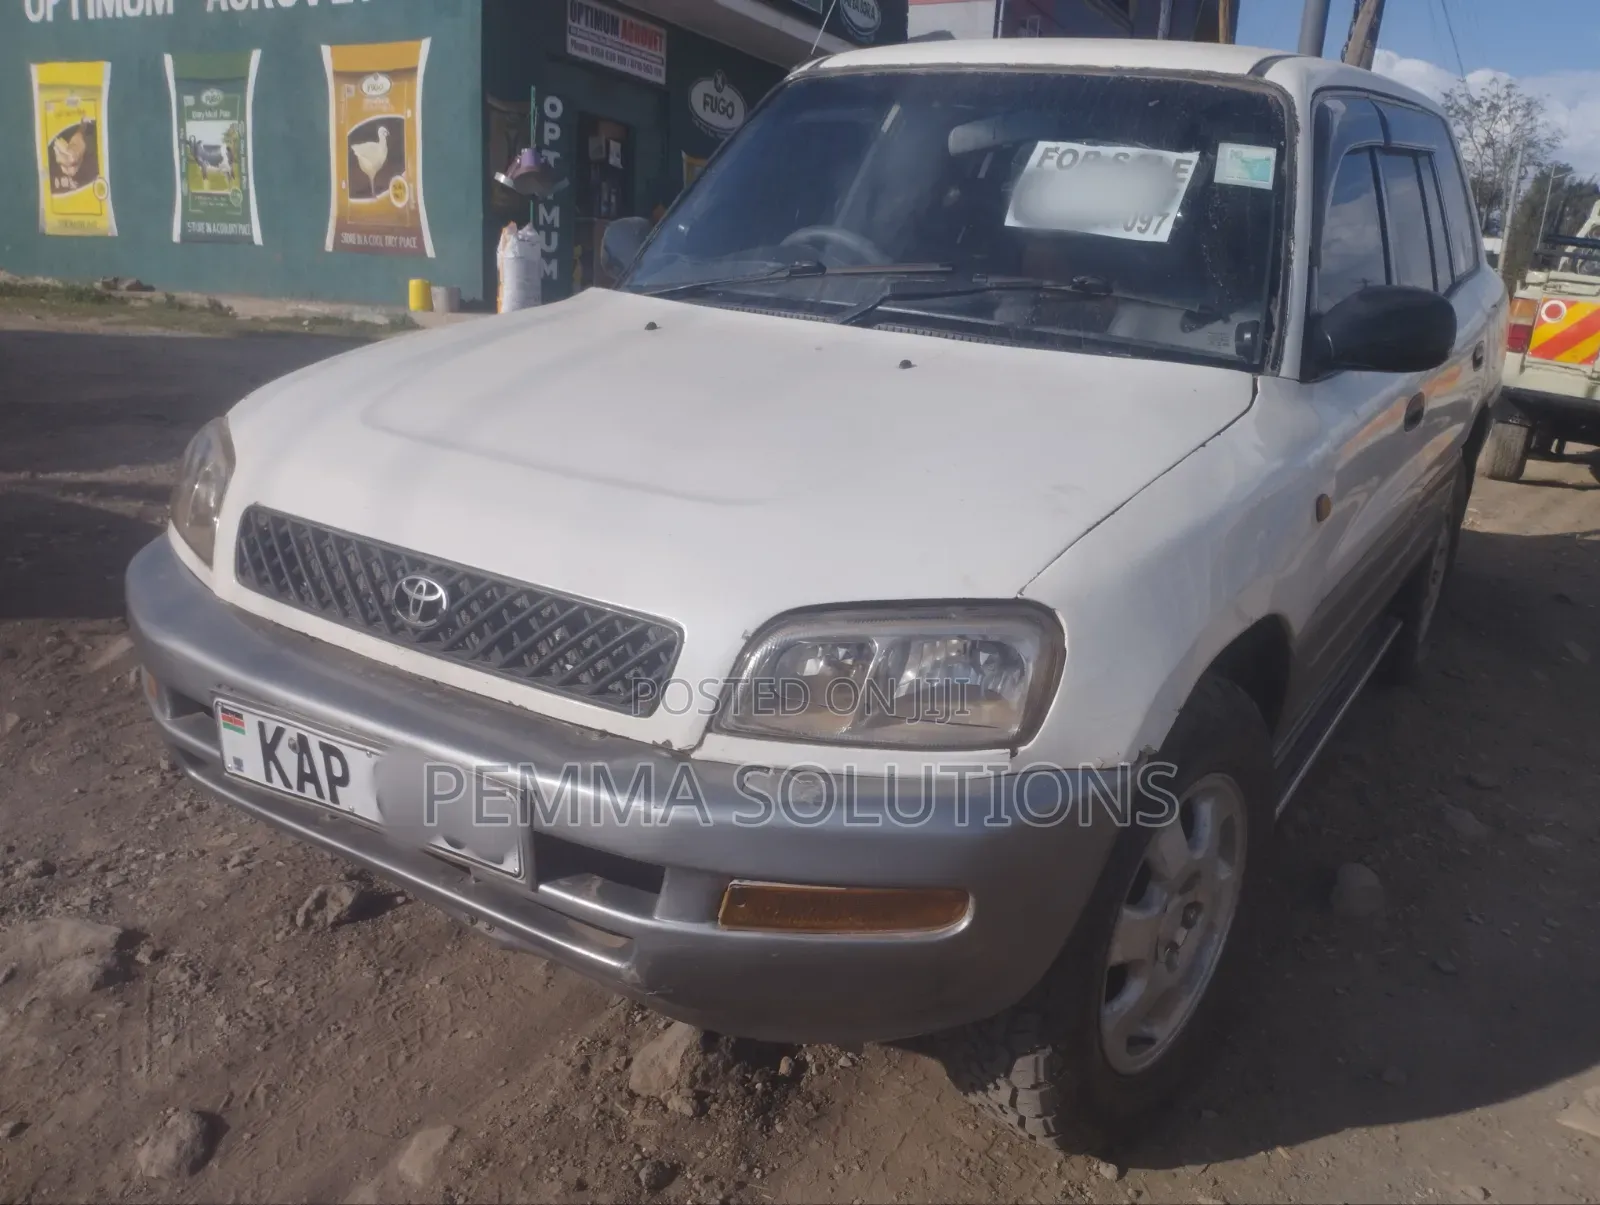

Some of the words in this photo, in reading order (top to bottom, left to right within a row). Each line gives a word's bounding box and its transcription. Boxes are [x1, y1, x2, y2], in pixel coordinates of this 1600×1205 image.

[570, 1, 620, 38] OPTIMUM
[620, 19, 663, 52] AGROVET
[703, 92, 735, 120] FUGO
[538, 95, 564, 281] OPTMUM
[257, 720, 350, 806] KAP
